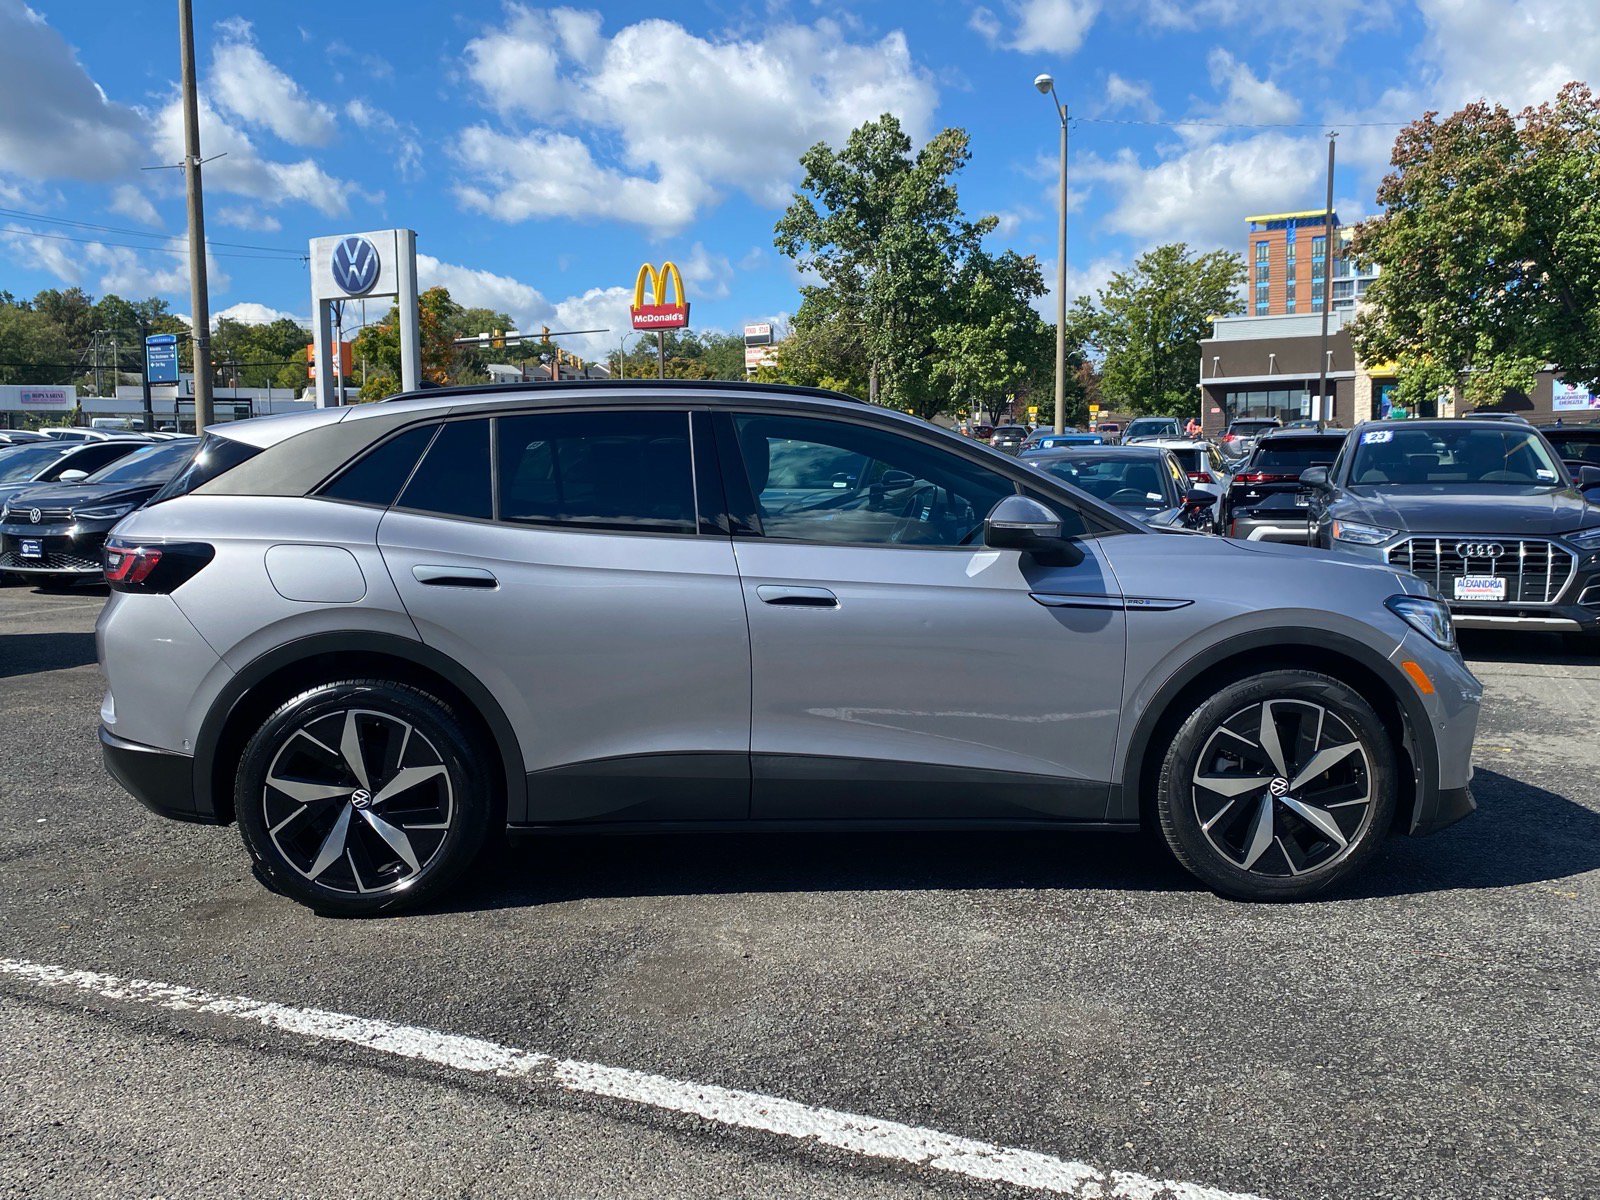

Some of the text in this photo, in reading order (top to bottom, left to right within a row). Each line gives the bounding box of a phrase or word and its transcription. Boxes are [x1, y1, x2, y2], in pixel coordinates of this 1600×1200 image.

[634, 313, 684, 323] McDonald's
[1370, 433, 1386, 441] 23
[1458, 580, 1502, 588] ALEXANDRIA
